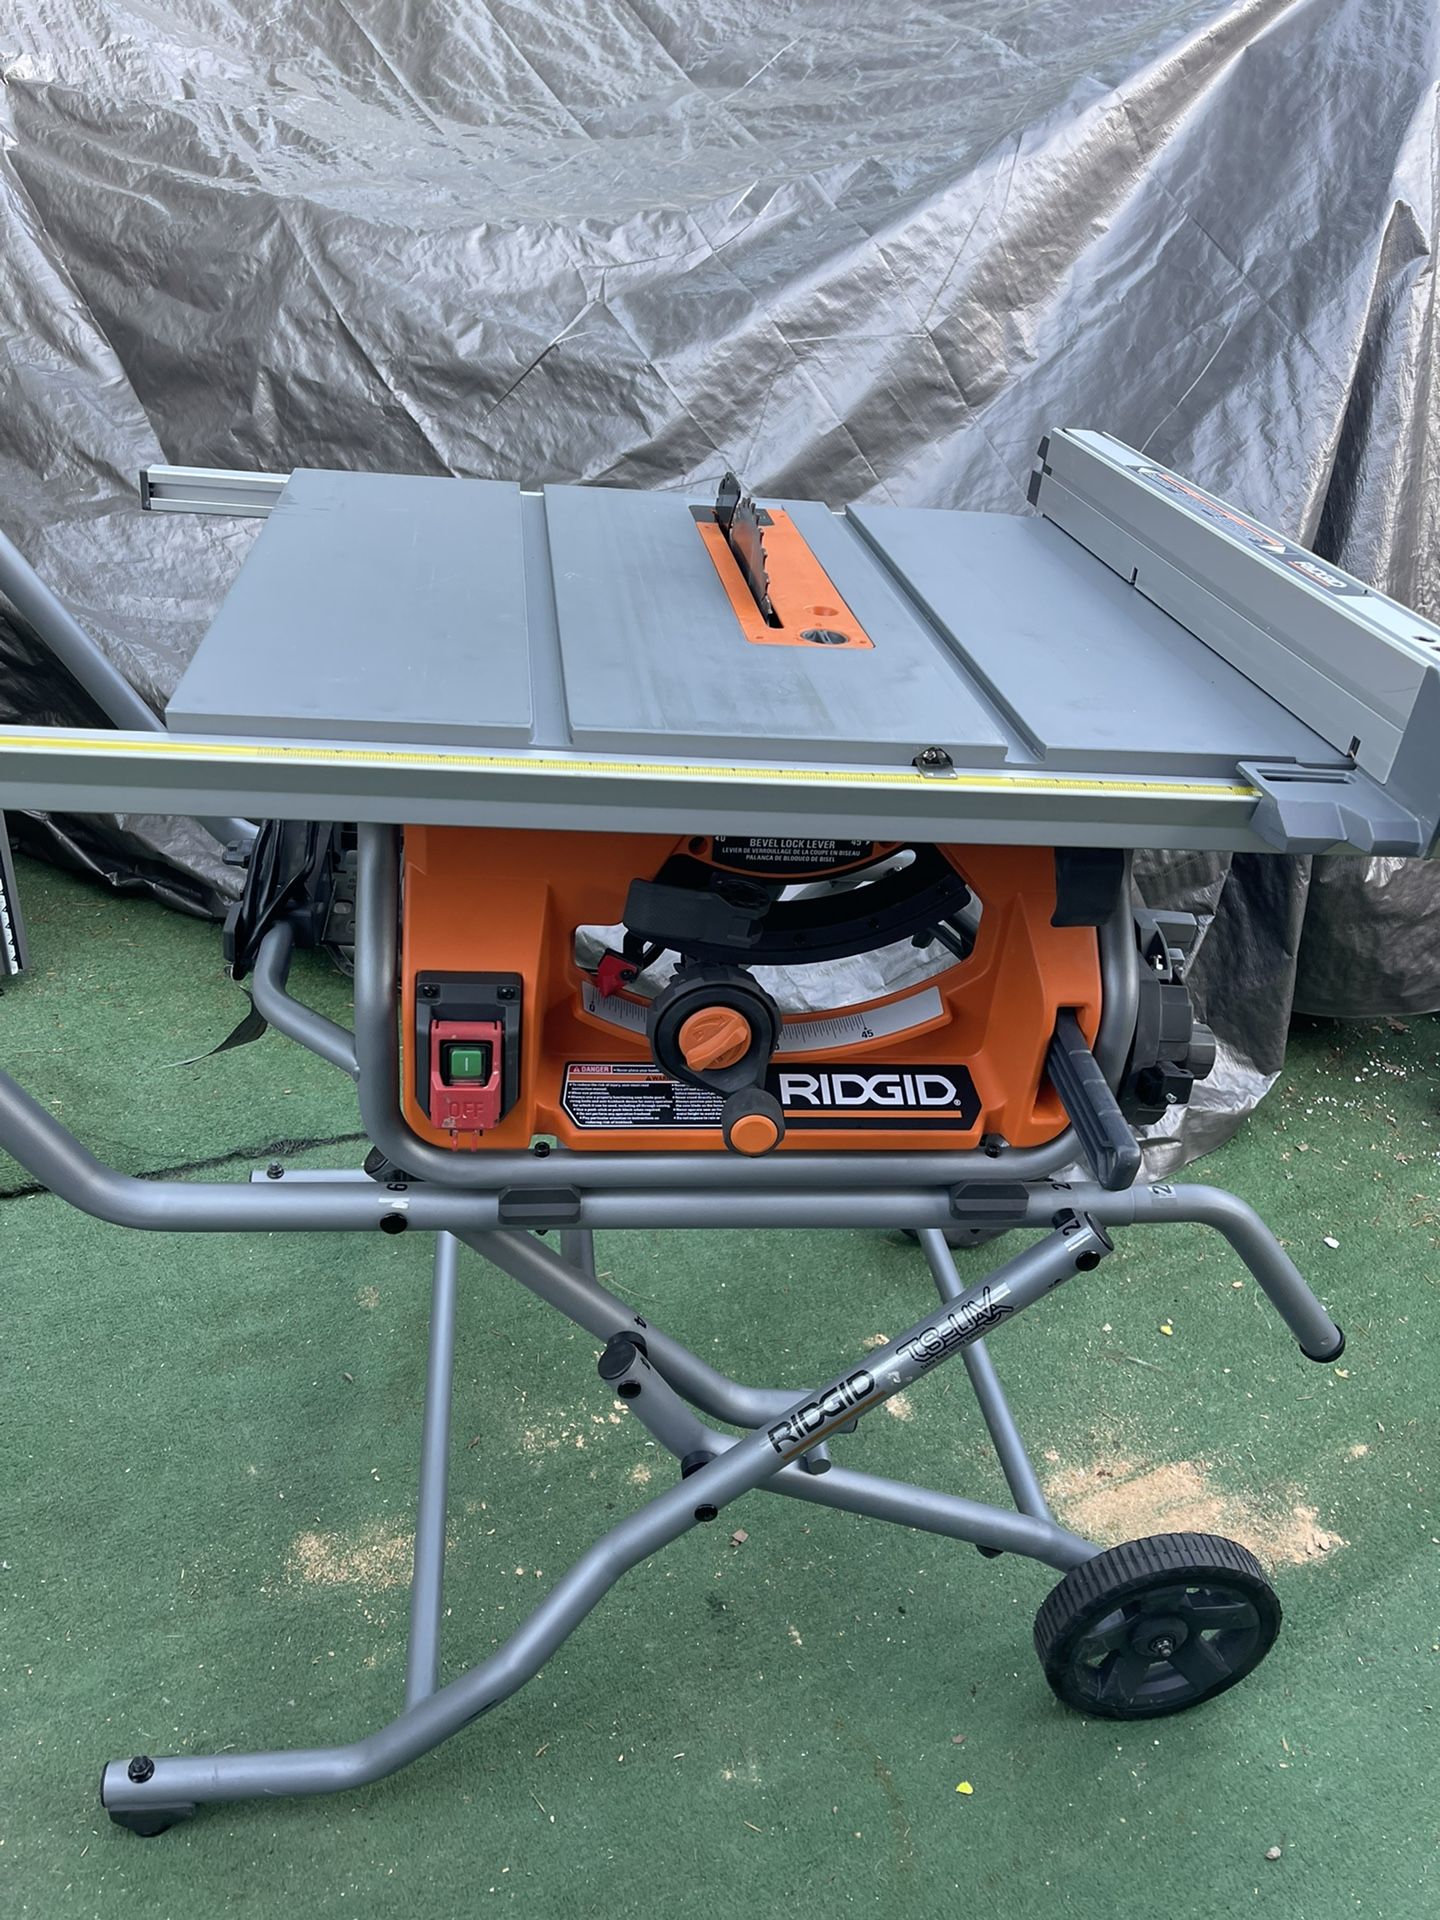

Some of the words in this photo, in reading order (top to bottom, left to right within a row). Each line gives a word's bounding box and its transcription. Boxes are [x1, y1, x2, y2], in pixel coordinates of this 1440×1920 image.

[750, 838, 778, 848] BEVEL
[780, 839, 805, 849] LOCK
[806, 840, 836, 850] LEVER
[861, 1029, 875, 1040] 45
[779, 1073, 958, 1105] RIDGID
[450, 1103, 485, 1119] OFF
[1152, 1184, 1172, 1195] 2
[1062, 1219, 1082, 1236] 2
[767, 1369, 876, 1453] RIDGID
